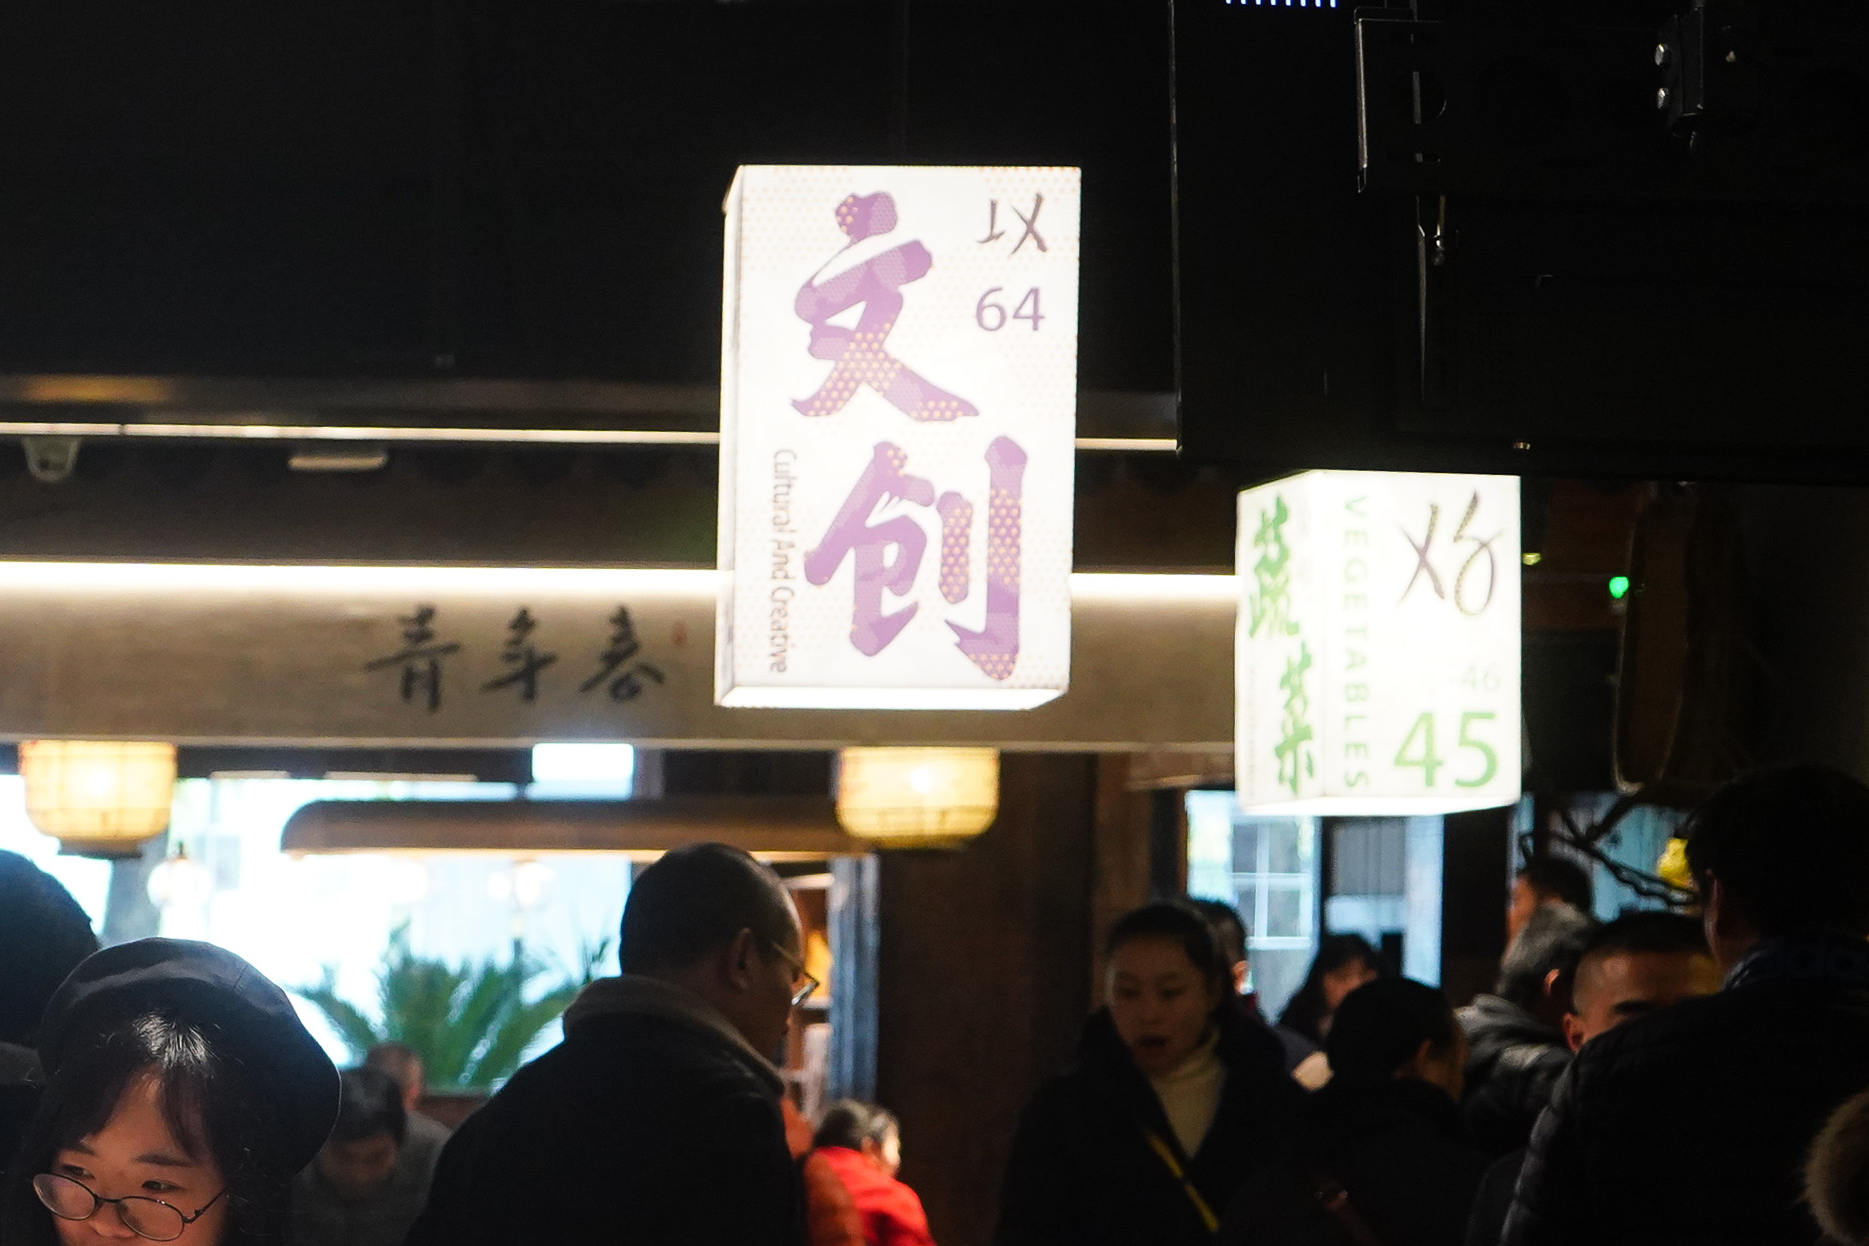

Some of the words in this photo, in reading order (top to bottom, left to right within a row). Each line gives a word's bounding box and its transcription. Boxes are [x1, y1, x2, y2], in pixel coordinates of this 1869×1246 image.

[975, 286, 1047, 333] 64
[791, 190, 1028, 680] 文创
[771, 449, 798, 534] Cultural
[771, 538, 798, 582] And
[769, 585, 798, 675] Creative
[1342, 496, 1371, 788] VEGETABLES
[1392, 711, 1500, 789] 45
